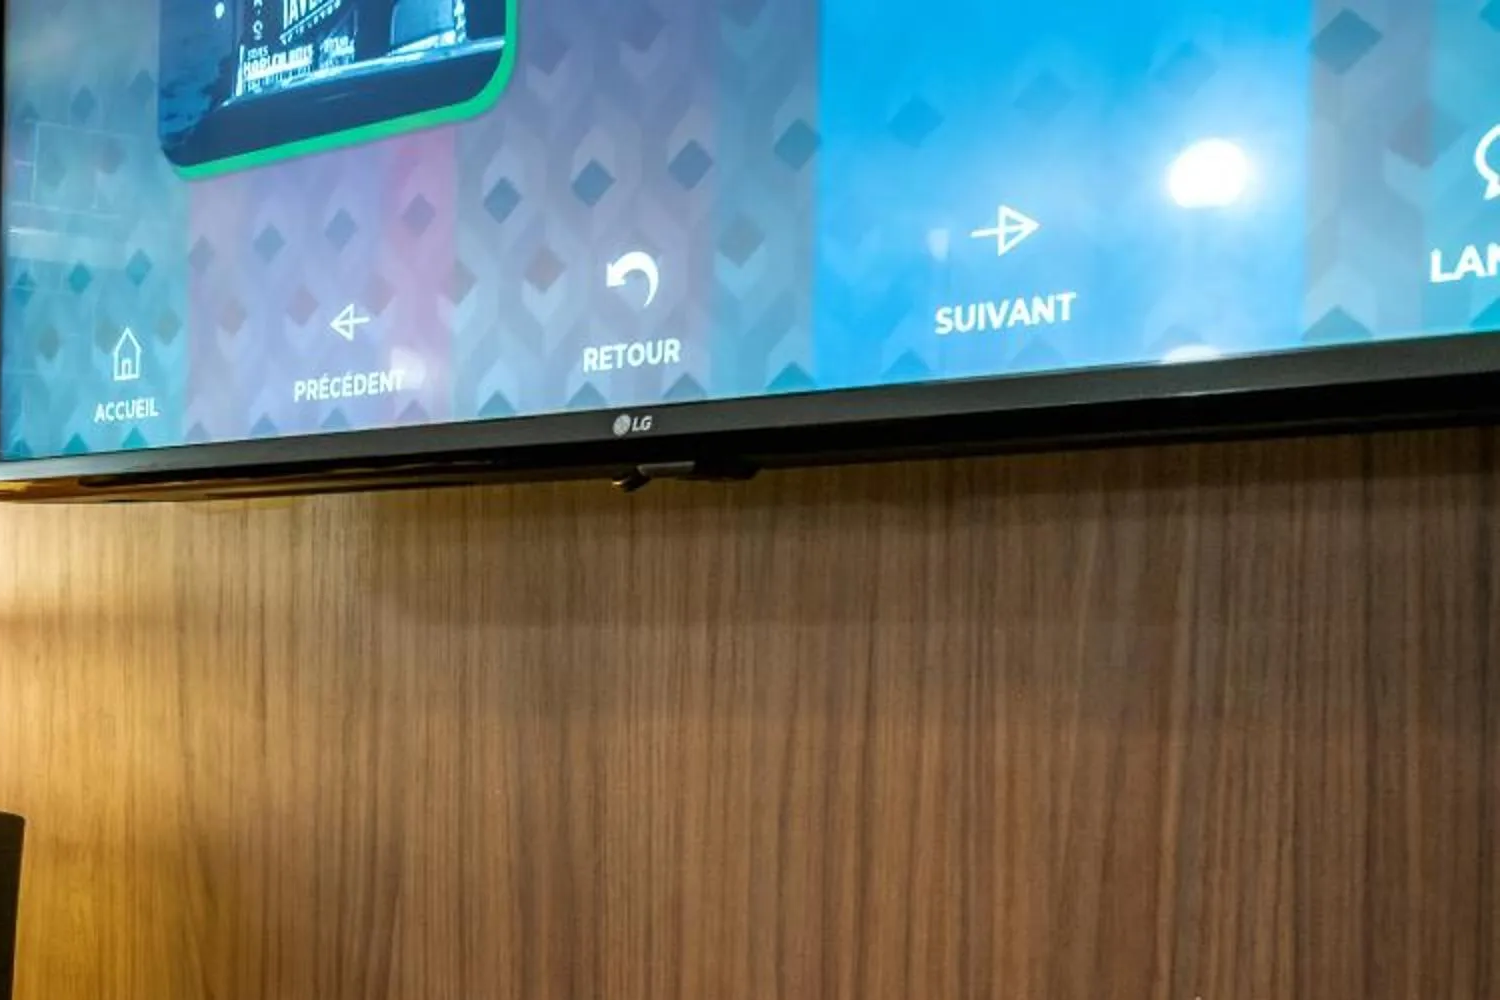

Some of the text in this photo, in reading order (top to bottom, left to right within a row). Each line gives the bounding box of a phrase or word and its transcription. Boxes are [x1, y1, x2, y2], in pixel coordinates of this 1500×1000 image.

[935, 291, 1077, 335] SUIVANT
[582, 337, 681, 373] RETOUR
[293, 368, 405, 403] PRÉCÉDENT
[94, 396, 160, 423] ACCUEIL
[631, 414, 653, 433] LG
